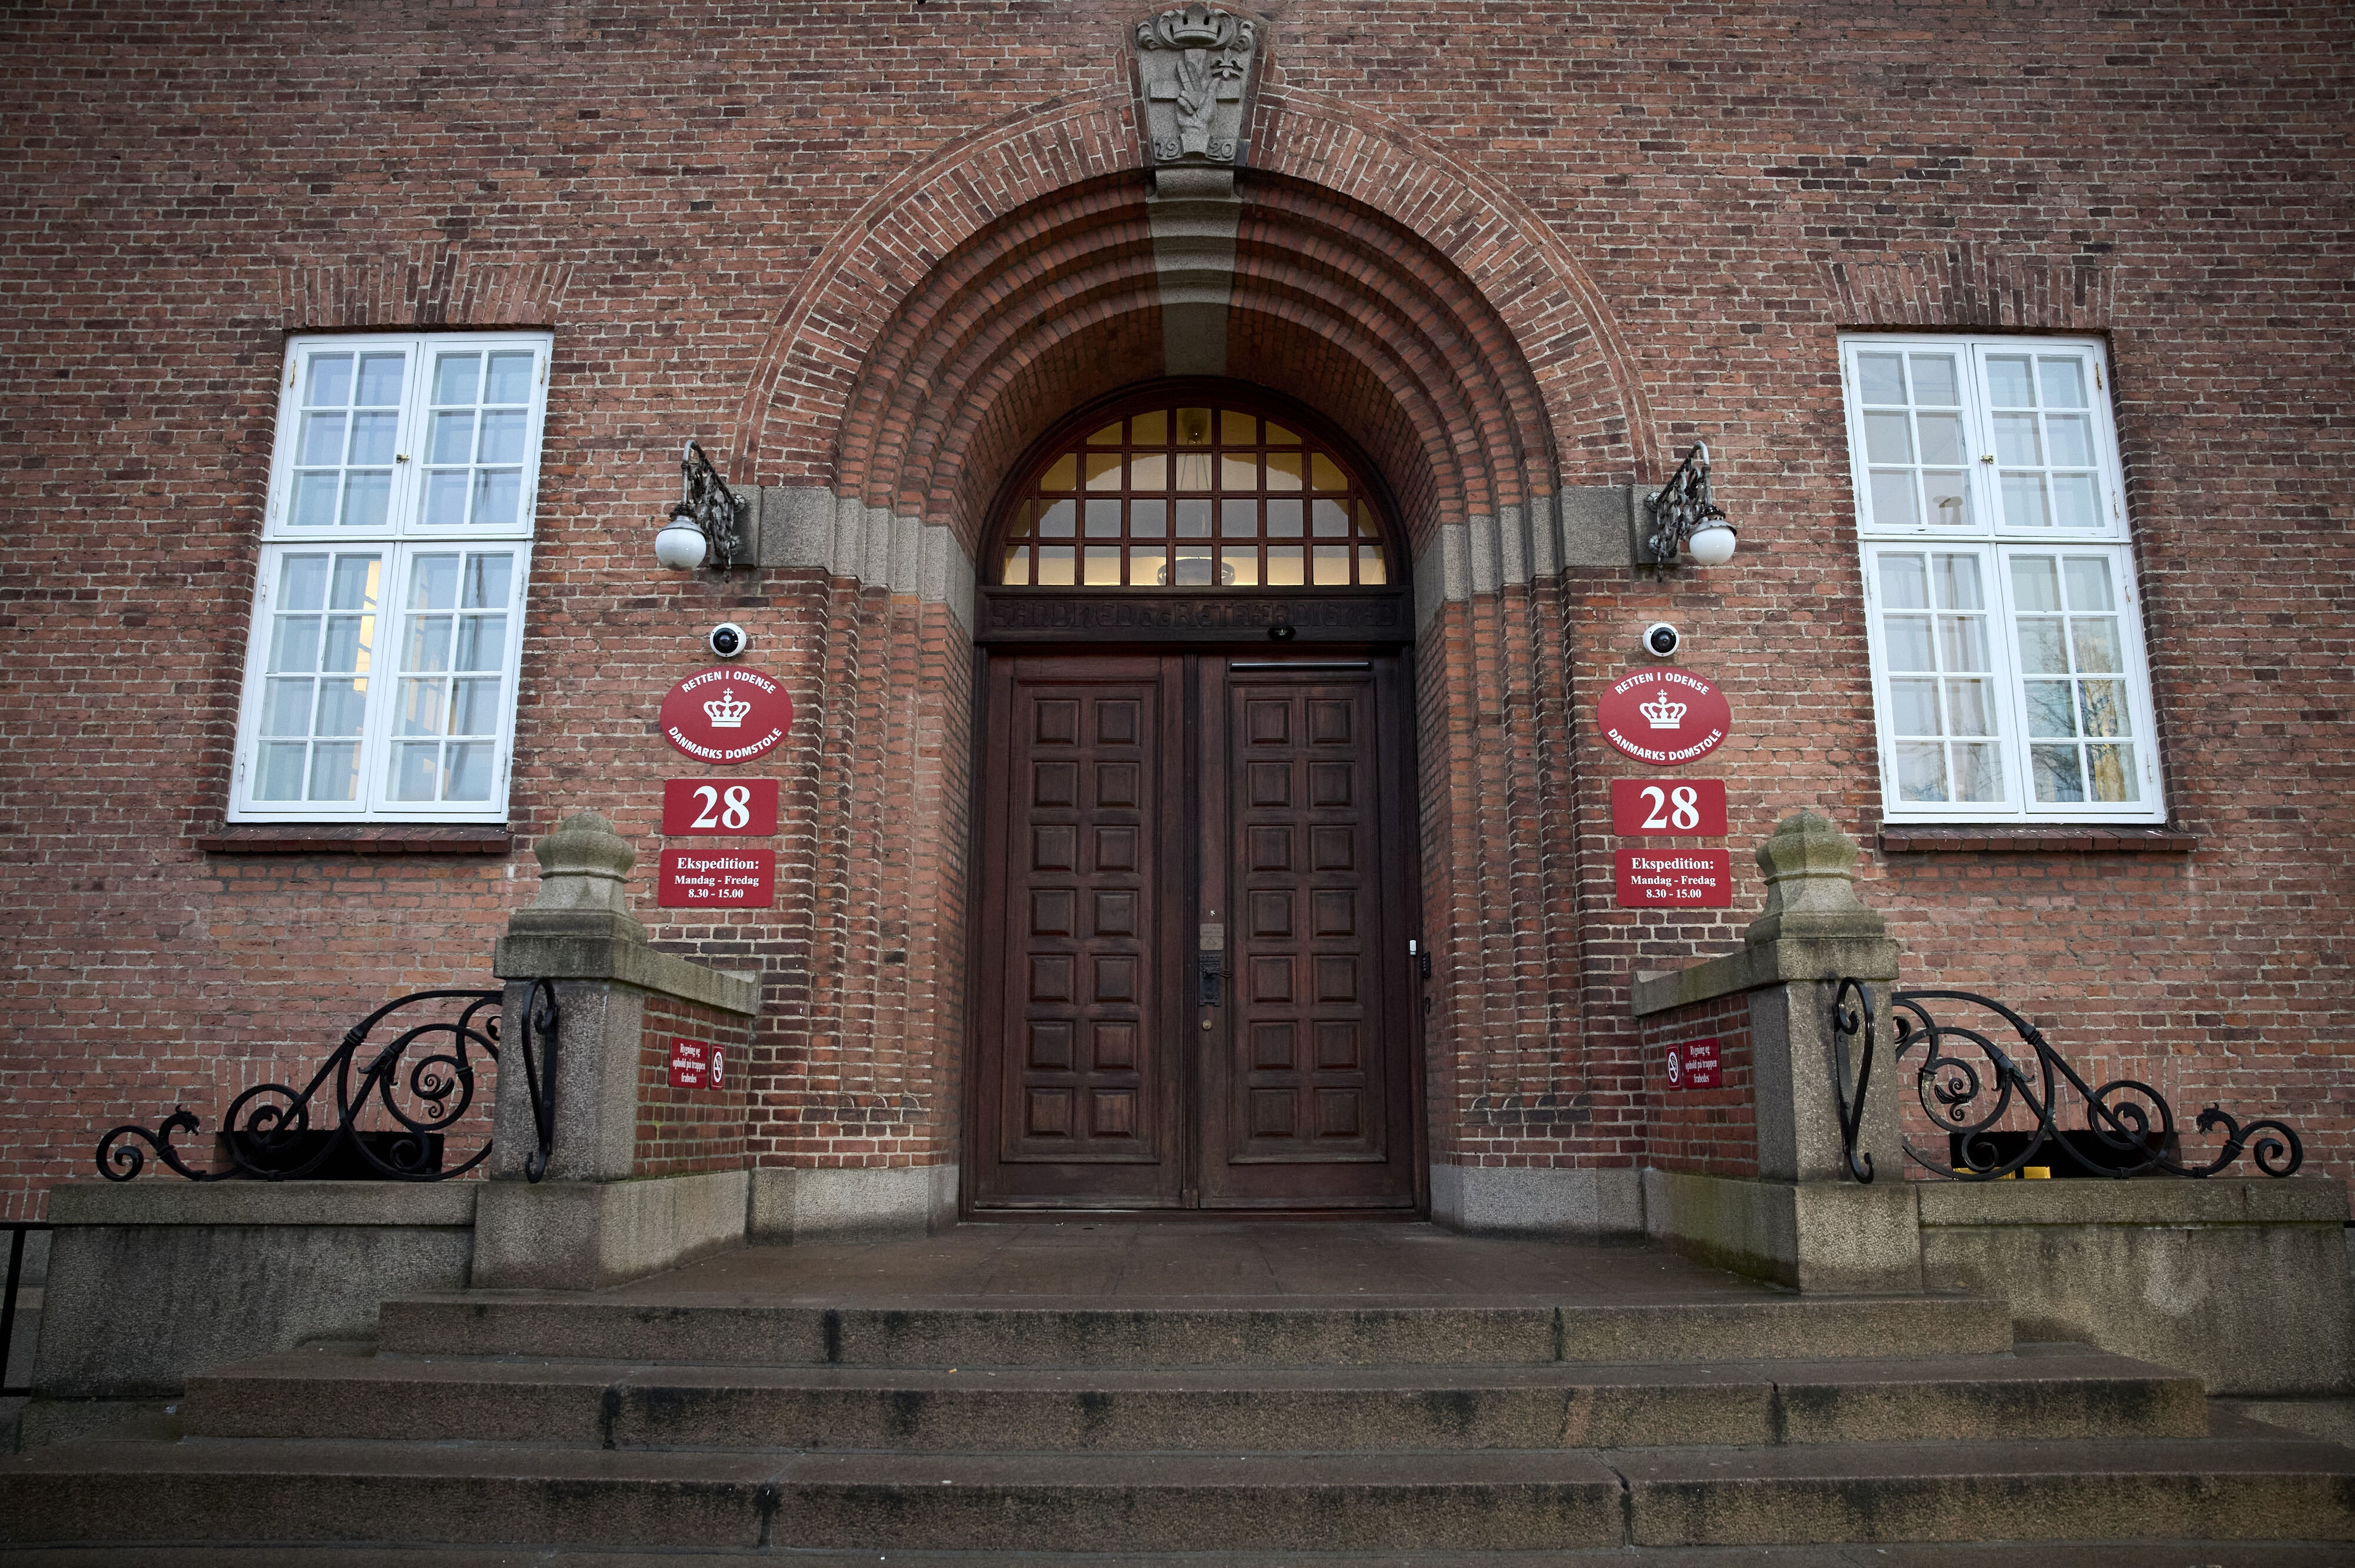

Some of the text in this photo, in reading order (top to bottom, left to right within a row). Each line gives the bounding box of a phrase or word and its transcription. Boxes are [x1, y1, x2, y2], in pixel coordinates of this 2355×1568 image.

[681, 670, 777, 695] RETTEN I ODENSE
[1614, 672, 1709, 695] RETTEN I ODENSE
[668, 726, 782, 759] DANMARKS DOMSTOLE
[1607, 727, 1722, 761] DANMARKS DOMSTOLE
[691, 786, 750, 829] 28
[1640, 786, 1699, 829] 28
[677, 858, 759, 872] Ekspedition:
[1631, 858, 1713, 872] Ekspedition:
[675, 876, 715, 886] Mandag
[725, 876, 759, 886] Fredag
[1631, 876, 1672, 886] Mandag
[1681, 876, 1716, 886] Fredag
[688, 889, 708, 898] 8.30
[719, 889, 744, 898] 15.00
[1646, 889, 1666, 898] 8.30
[1676, 889, 1701, 898] 15.00
[680, 1044, 700, 1057] Rygning og
[1690, 1045, 1710, 1057] Rygning og
[673, 1058, 705, 1072] ophold på trappen
[1686, 1059, 1717, 1072] ophold på trappen
[681, 1073, 696, 1083] frabedes
[1694, 1074, 1709, 1083] frabedes
